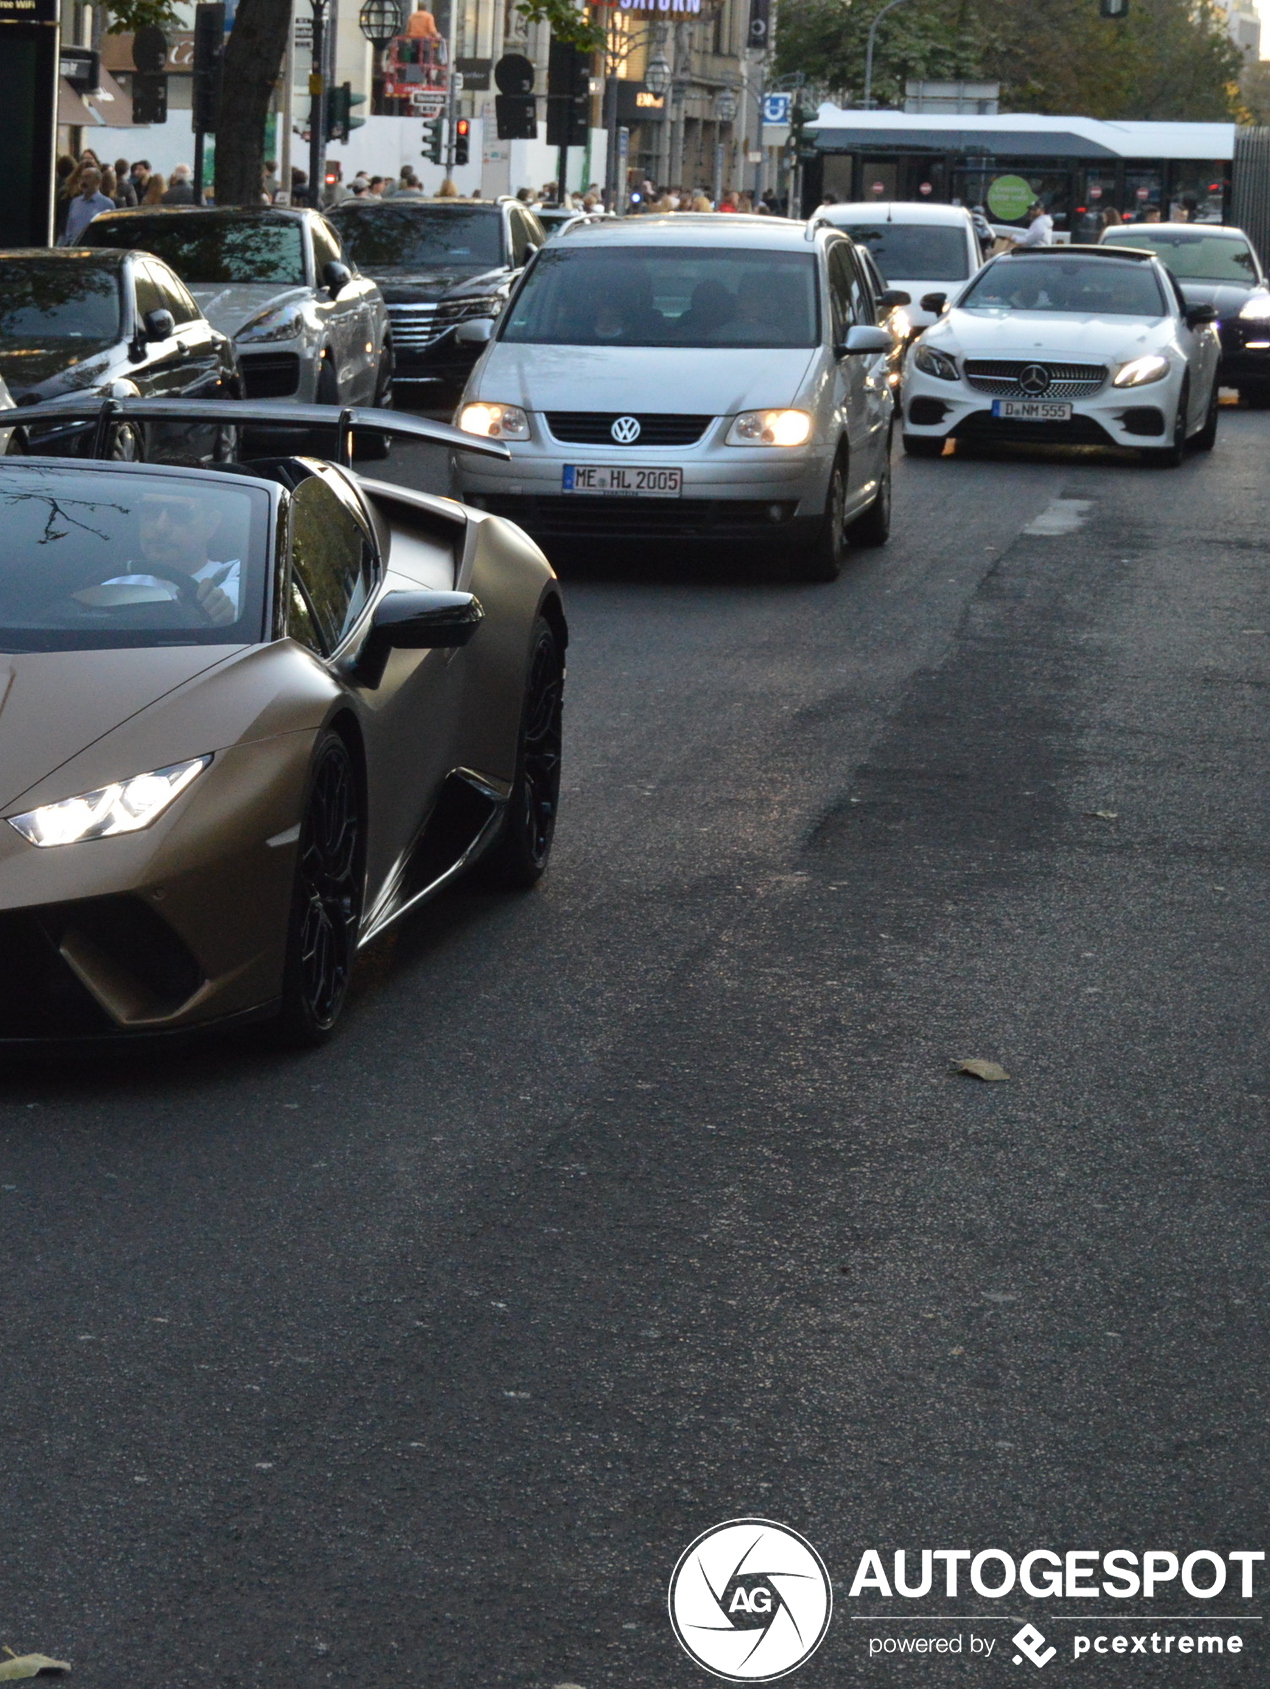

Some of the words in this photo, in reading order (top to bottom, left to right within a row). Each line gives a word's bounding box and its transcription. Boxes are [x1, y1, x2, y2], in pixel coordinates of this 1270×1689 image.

[1041, 404, 1066, 418] 555
[575, 468, 597, 487] ME
[610, 470, 632, 489] HL
[636, 471, 678, 490] 2005
